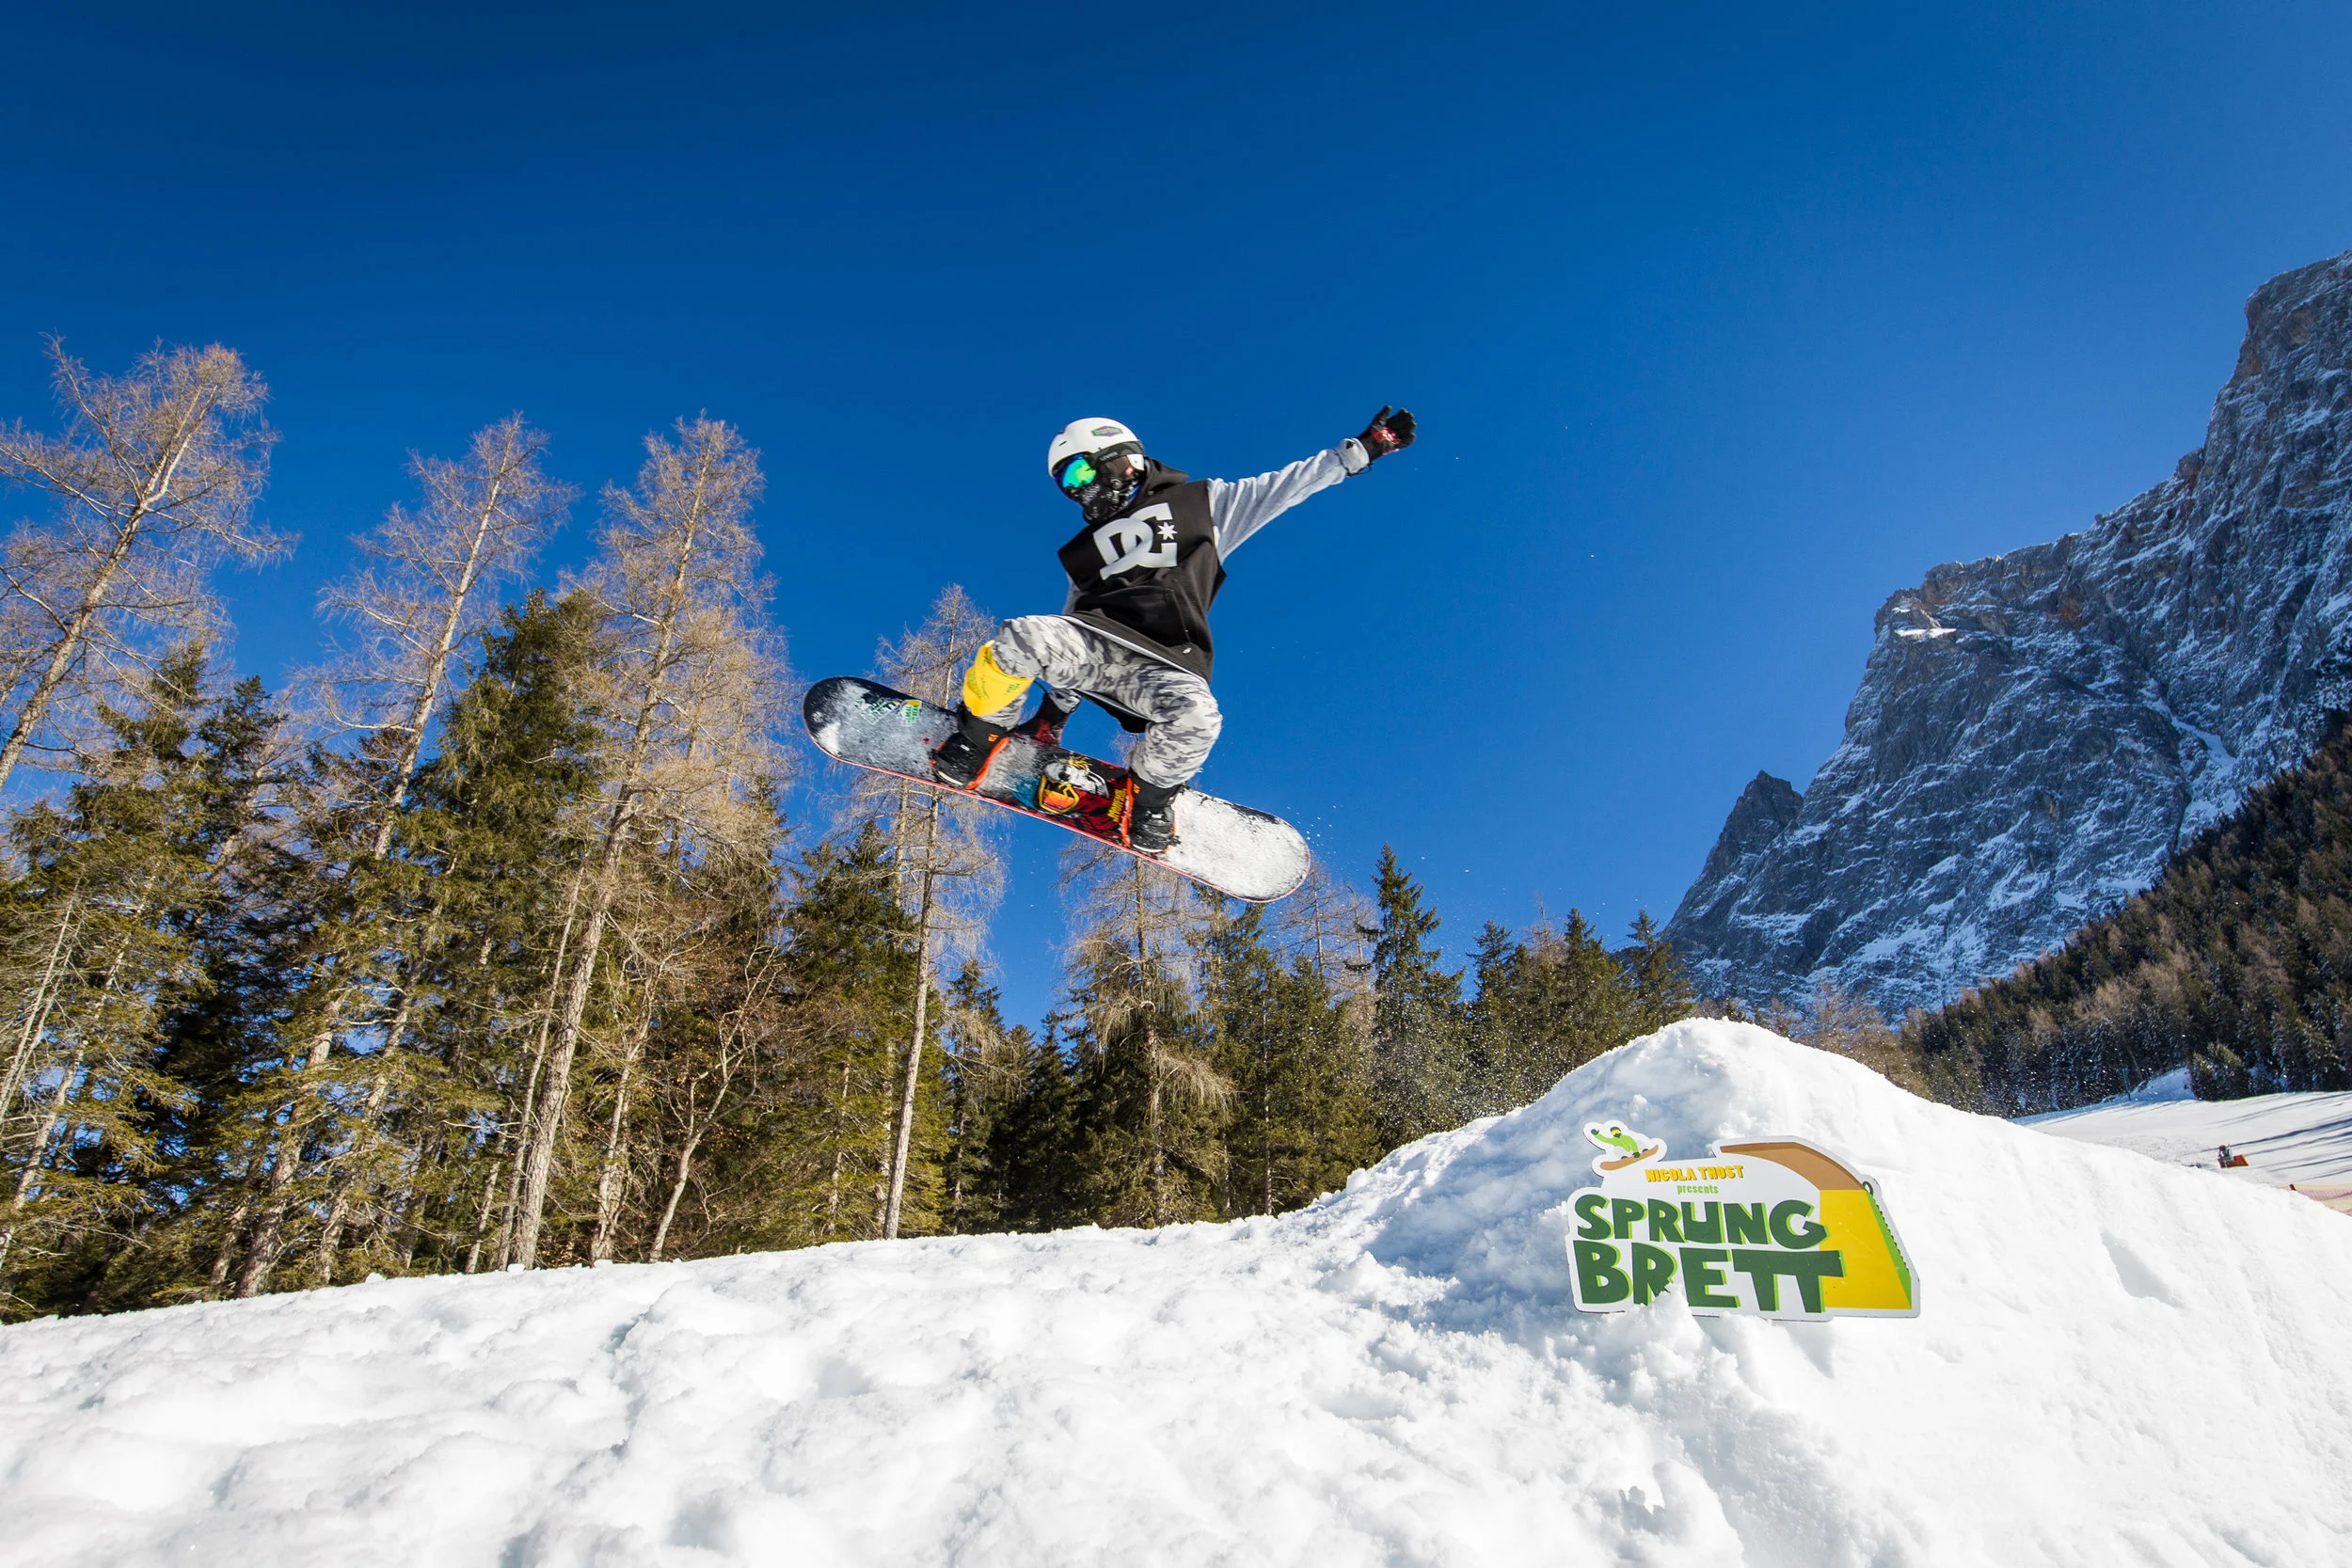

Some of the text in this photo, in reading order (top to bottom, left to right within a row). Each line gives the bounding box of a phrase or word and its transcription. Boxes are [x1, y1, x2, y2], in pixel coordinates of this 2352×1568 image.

[1093, 502, 1178, 580] DC
[1645, 1164, 1743, 1182] NICOLA THOST
[1677, 1184, 1720, 1195] presents
[1574, 1194, 1831, 1250] SPRUNG
[1572, 1240, 1847, 1313] BRETT
